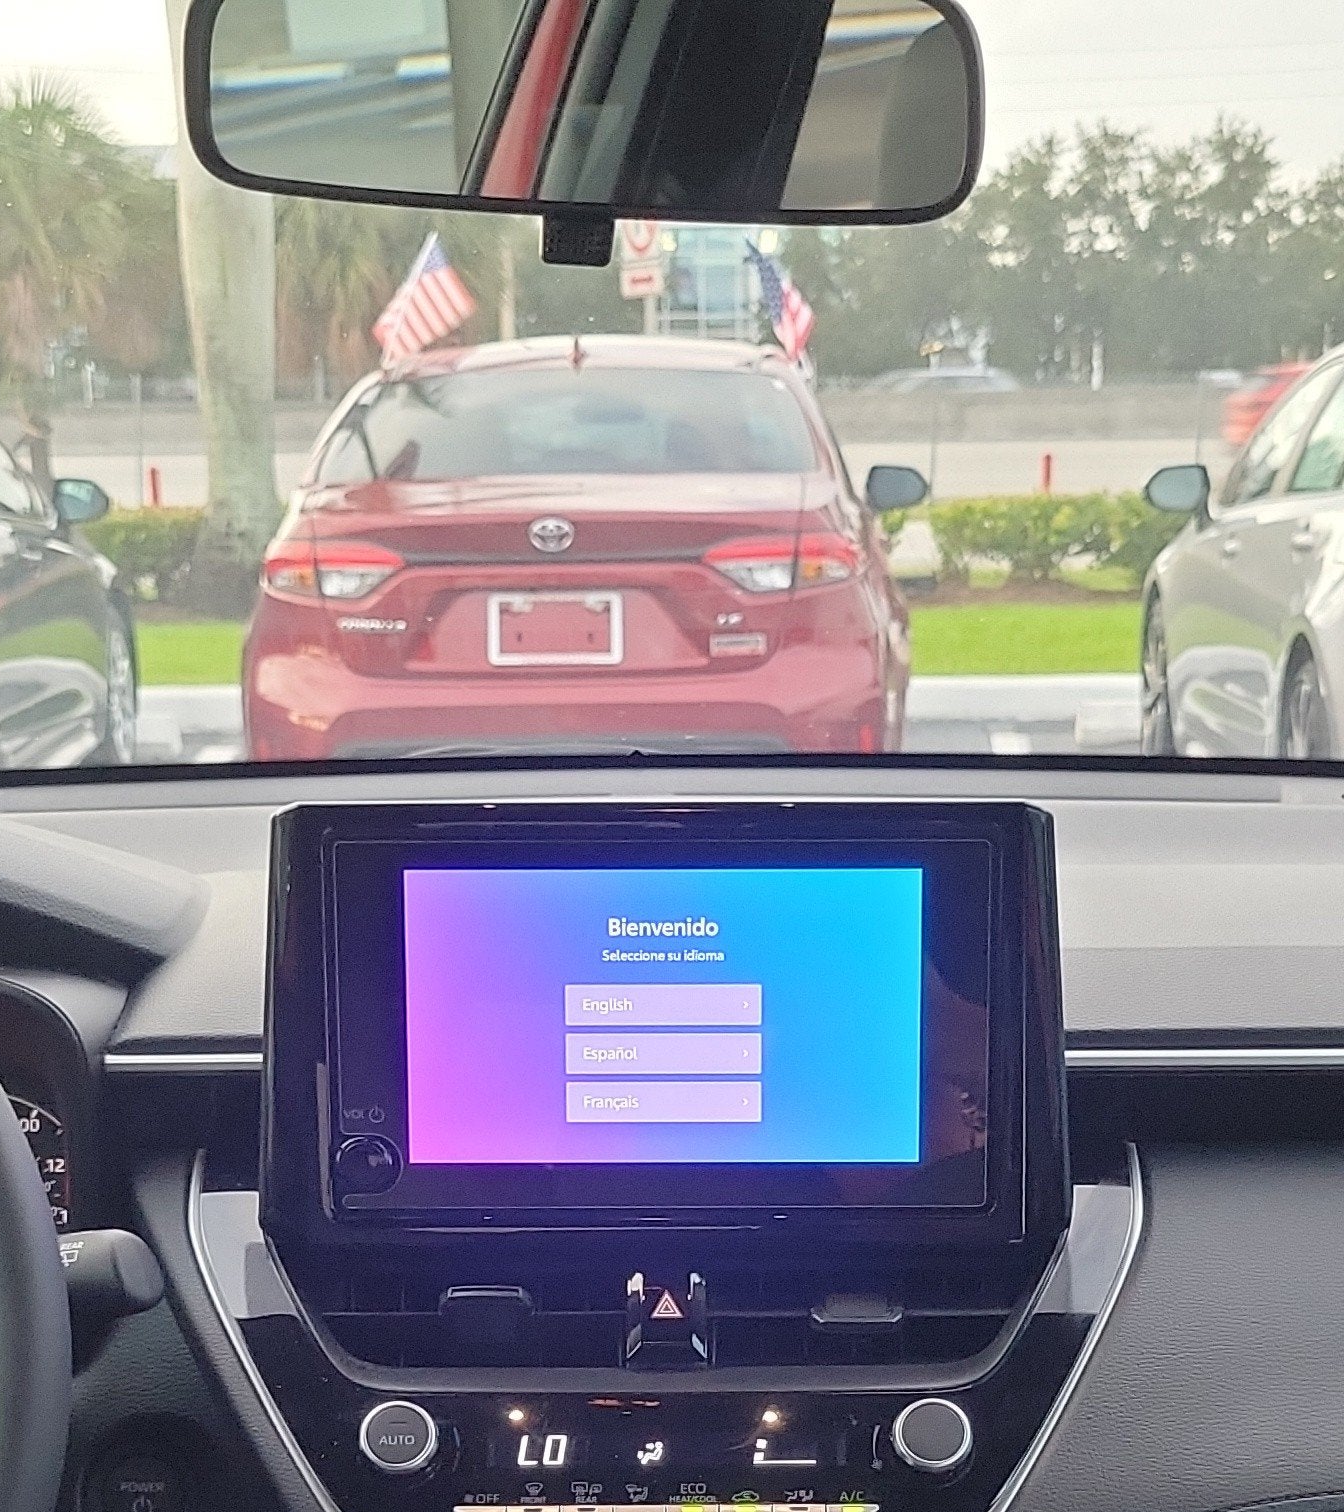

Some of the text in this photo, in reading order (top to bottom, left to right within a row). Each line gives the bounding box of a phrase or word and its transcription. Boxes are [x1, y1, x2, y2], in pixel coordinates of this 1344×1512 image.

[607, 916, 720, 937] Bienvenido
[601, 949, 726, 962] Seleccione su idioma
[582, 998, 633, 1014] English
[582, 1046, 638, 1062] Español
[583, 1095, 639, 1110] Français
[379, 1435, 415, 1445] AUTO
[517, 1434, 568, 1467] LO
[680, 1483, 706, 1495] ECO
[839, 1490, 865, 1501] A/C
[475, 1494, 501, 1504] OFF
